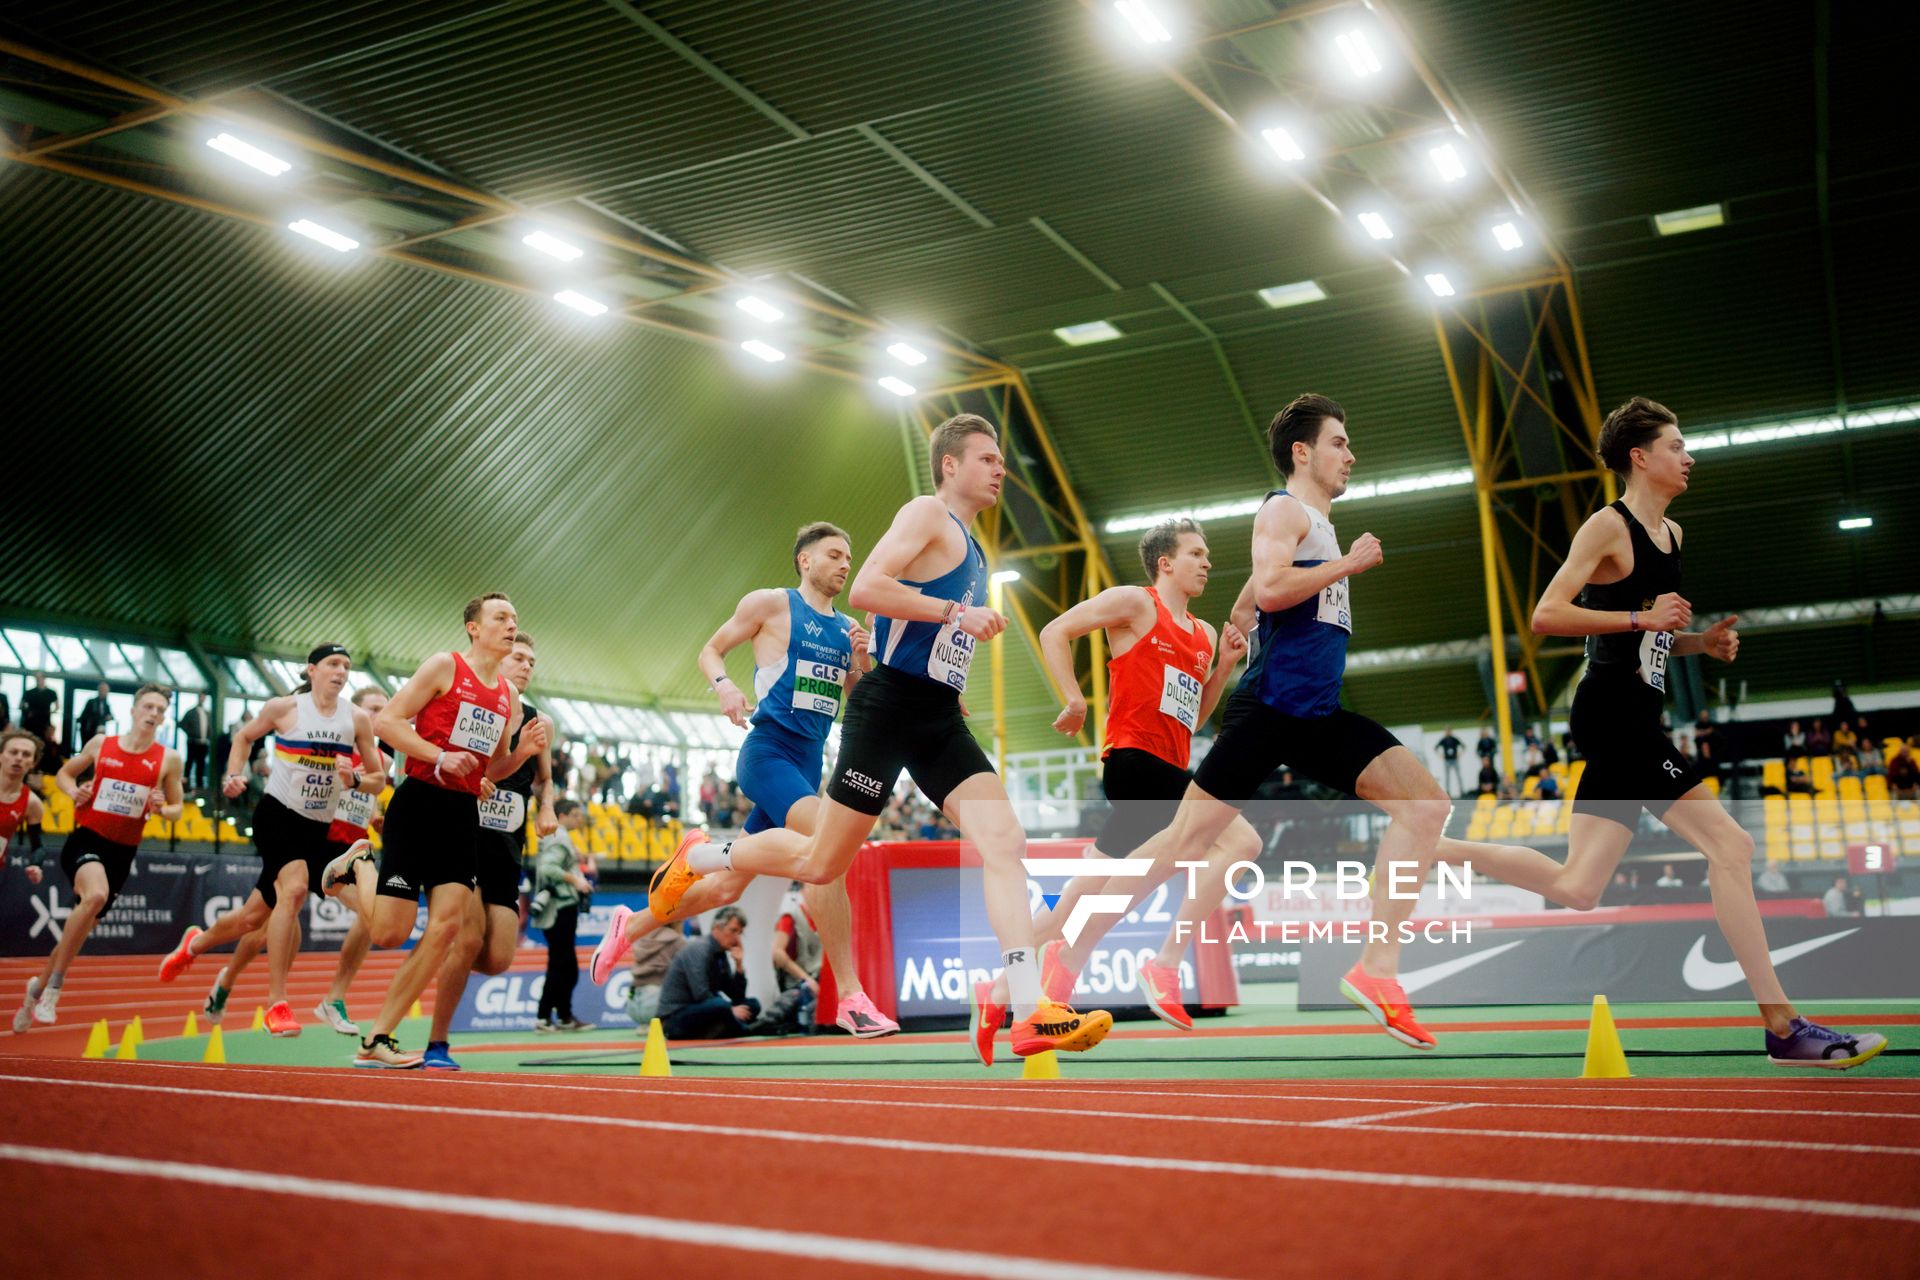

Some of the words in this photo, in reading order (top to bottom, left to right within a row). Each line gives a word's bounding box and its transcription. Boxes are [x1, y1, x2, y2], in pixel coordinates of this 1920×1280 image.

[812, 664, 839, 682] GLS
[1178, 672, 1199, 696] GLS
[472, 707, 496, 726] GLS
[459, 717, 500, 743] C.ARNOLD
[112, 781, 137, 794] GLS
[306, 774, 334, 786] GLS
[351, 790, 370, 803] GLS
[480, 801, 515, 818] GRAF
[1865, 846, 1882, 869] 3
[1031, 1018, 1081, 1037] NITRO
